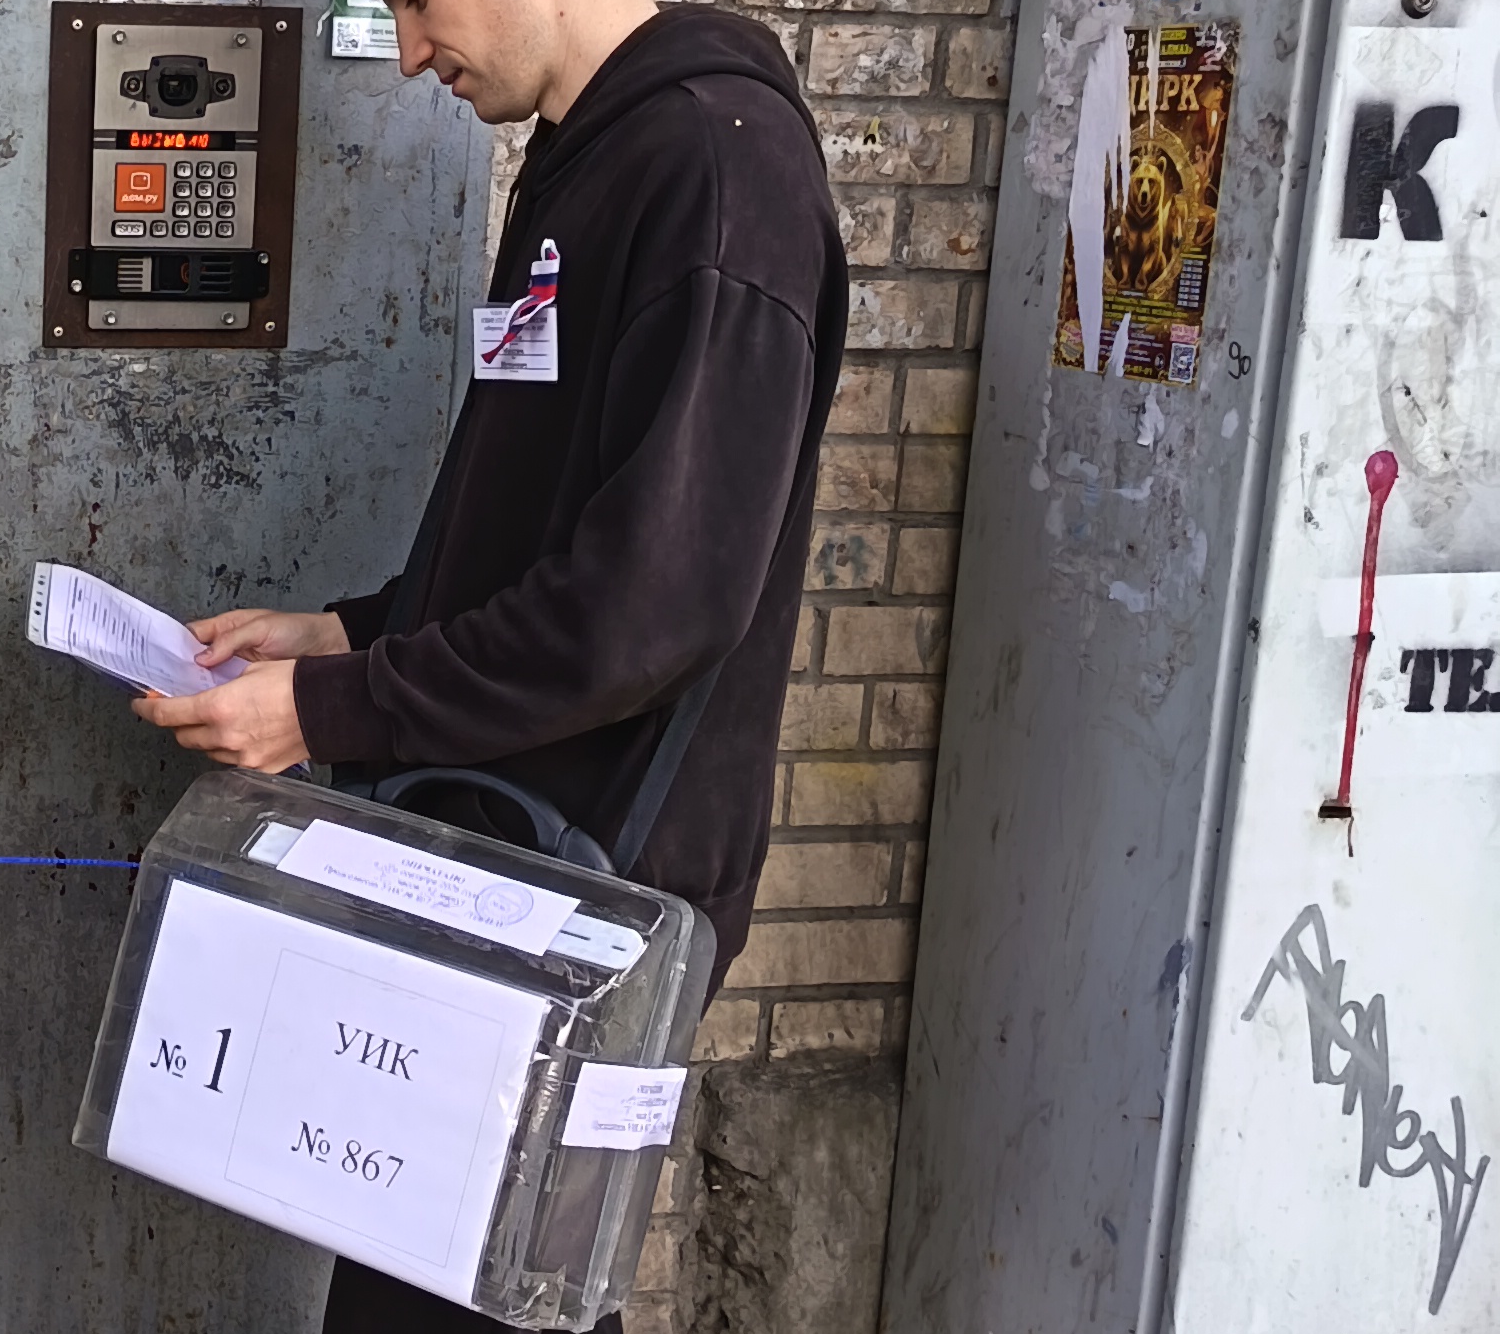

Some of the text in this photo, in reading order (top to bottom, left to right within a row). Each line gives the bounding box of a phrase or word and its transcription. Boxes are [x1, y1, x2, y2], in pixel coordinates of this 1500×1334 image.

[118, 224, 140, 233] SOS
[150, 1028, 232, 1093] № 1
[334, 1021, 419, 1081] УИК
[291, 1120, 404, 1188] № 867
